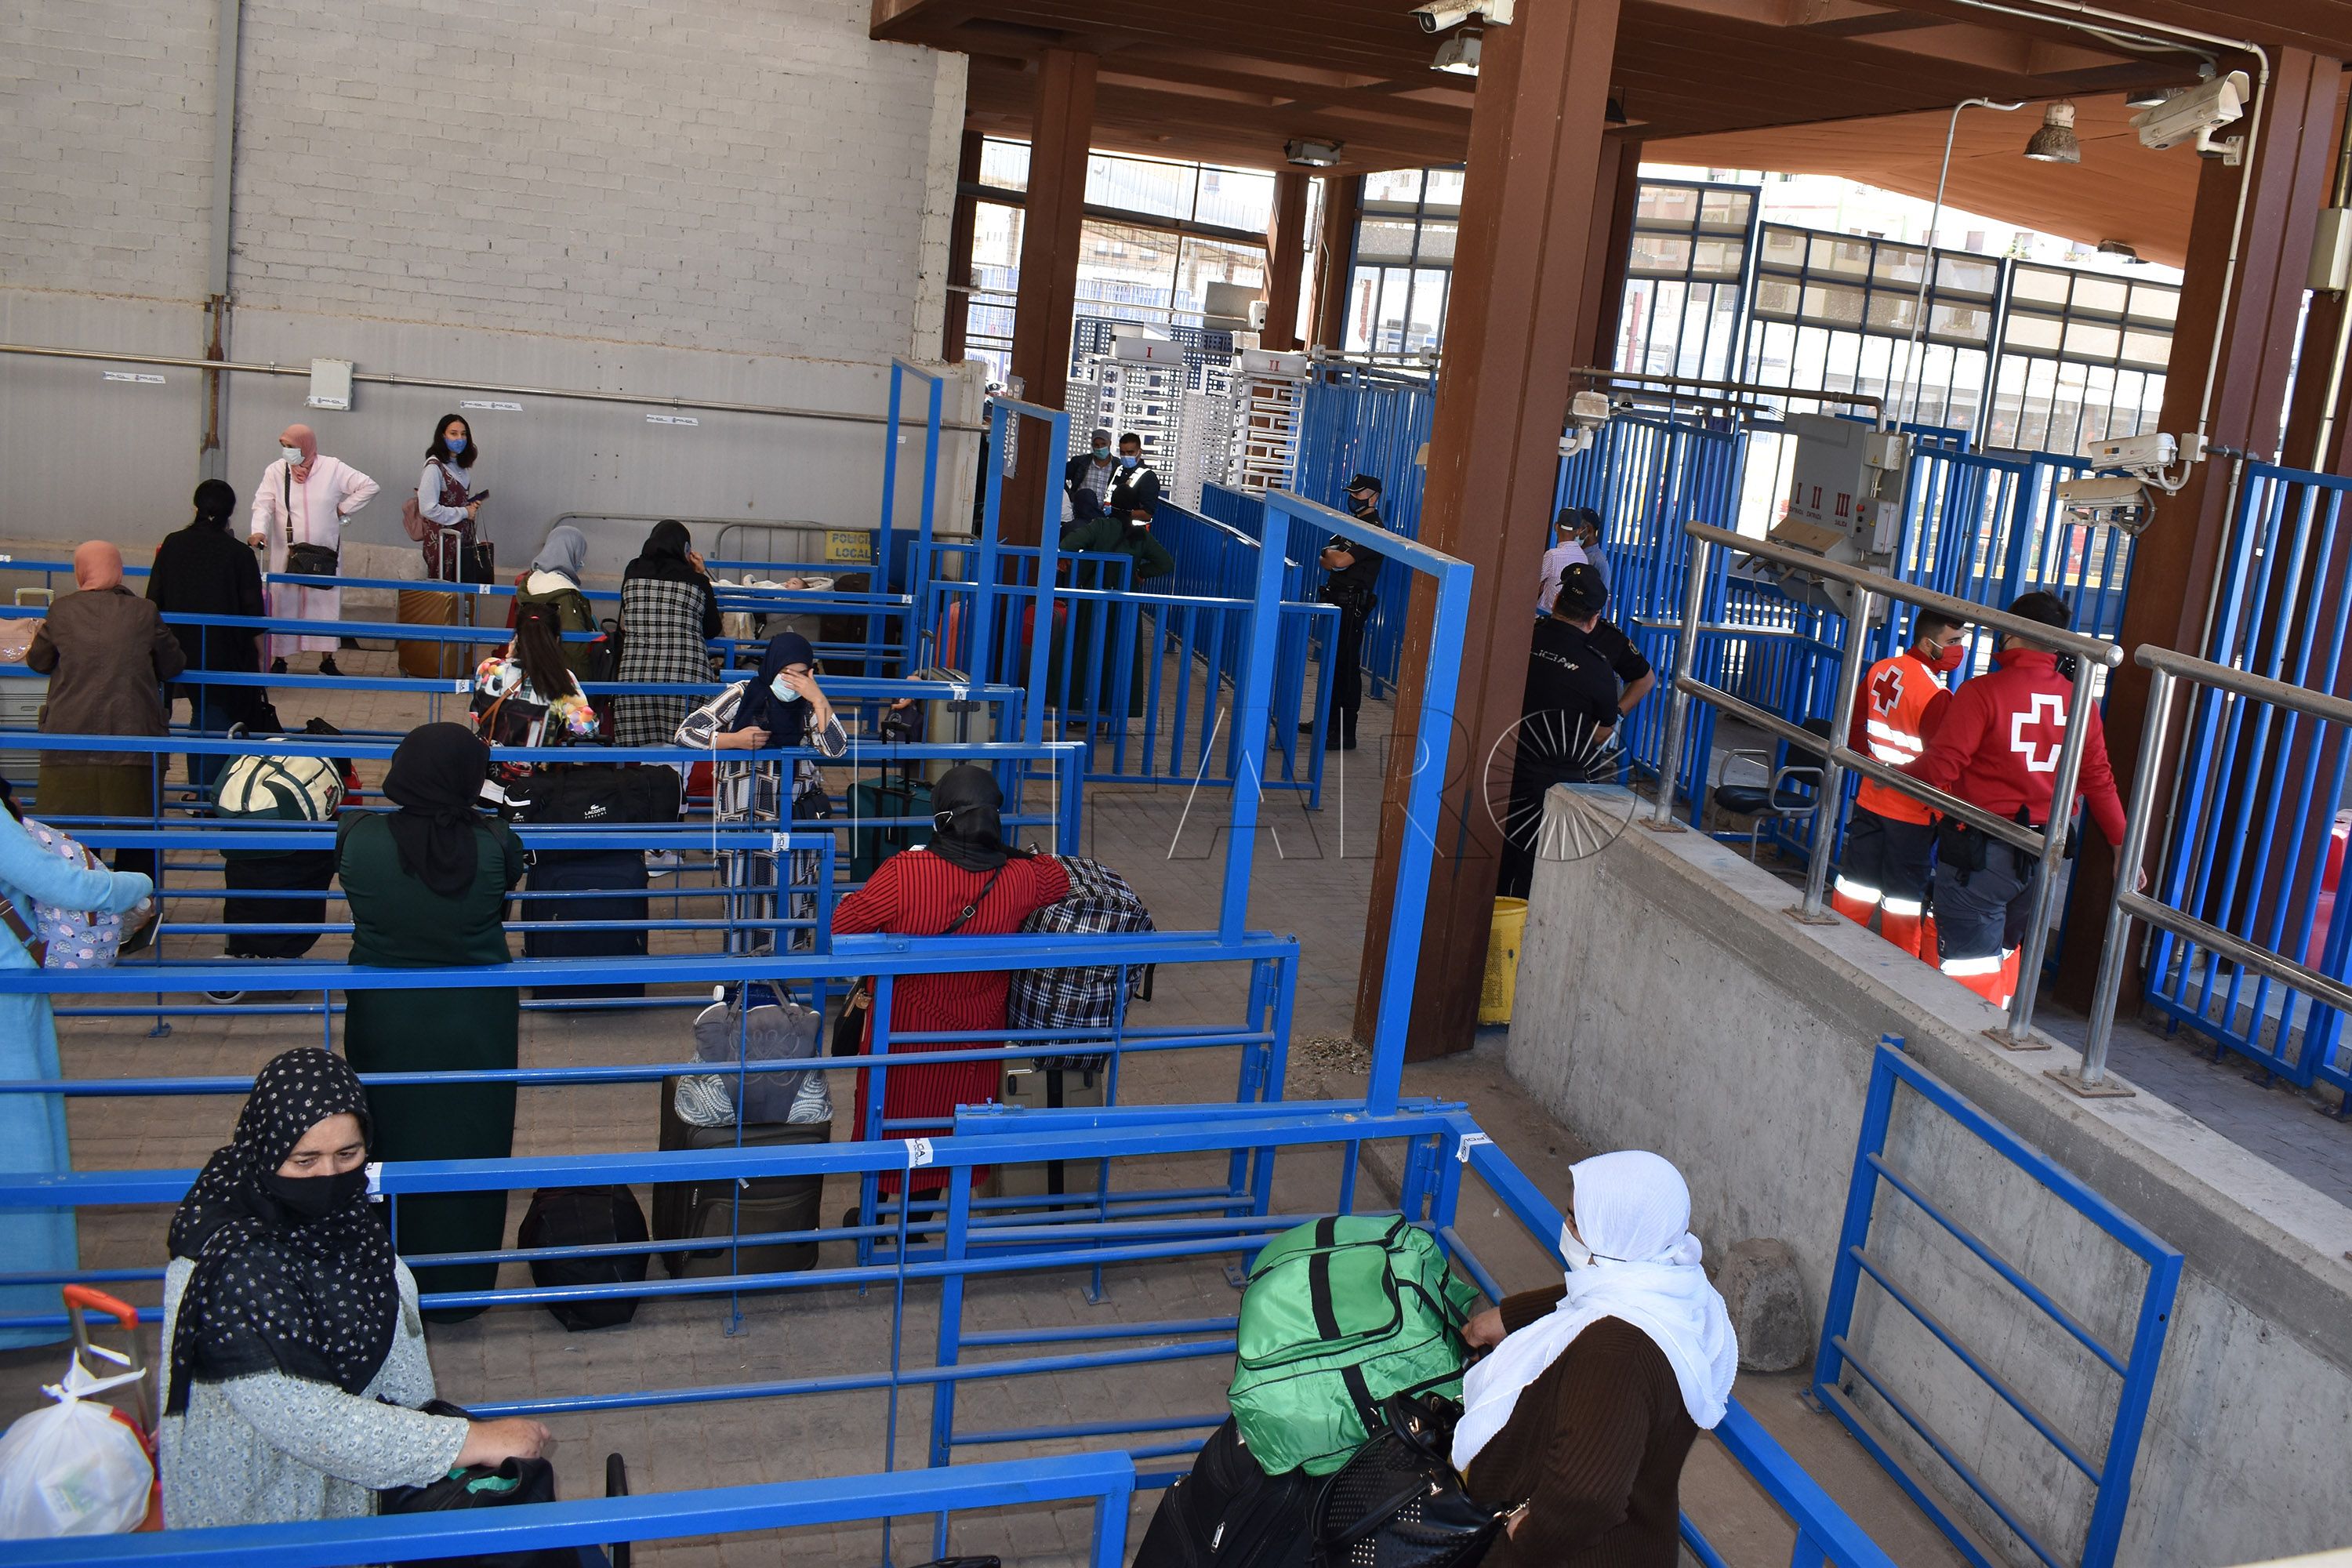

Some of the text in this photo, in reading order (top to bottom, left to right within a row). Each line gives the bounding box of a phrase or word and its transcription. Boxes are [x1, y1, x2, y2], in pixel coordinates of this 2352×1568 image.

[1007, 384, 1020, 467] PASAPORES
[1811, 486, 1823, 510] II
[1835, 492, 1850, 517] III
[833, 533, 870, 544] POLICI
[836, 547, 870, 558] LOCAL
[584, 807, 606, 815] LACOSTE
